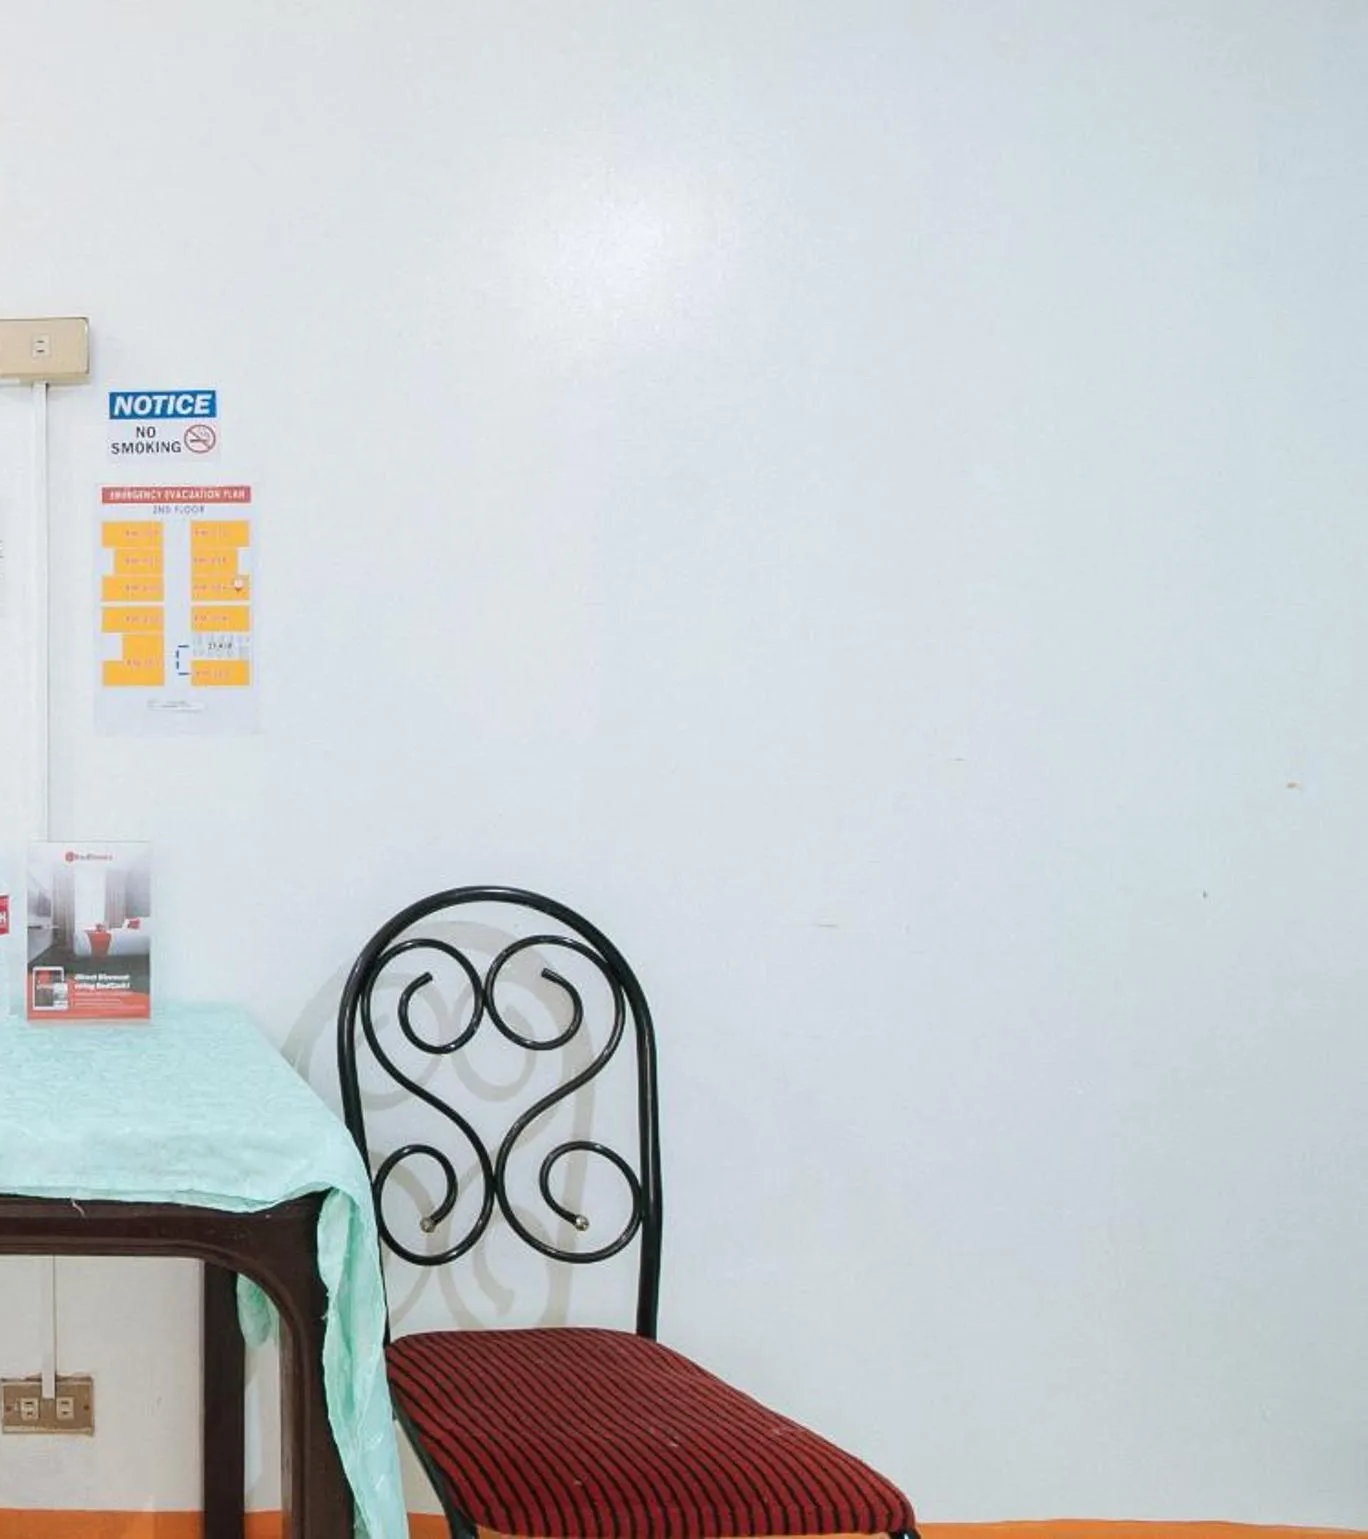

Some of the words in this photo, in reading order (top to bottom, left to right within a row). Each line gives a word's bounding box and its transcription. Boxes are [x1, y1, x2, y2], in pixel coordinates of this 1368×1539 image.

[113, 393, 212, 417] NOTICE
[135, 426, 156, 439] NO
[111, 441, 182, 455] SMOKING
[109, 490, 162, 501] EMERGENCY
[164, 489, 221, 501] EVACUATION
[223, 489, 246, 500] PLAN
[174, 504, 205, 515] FLOOR
